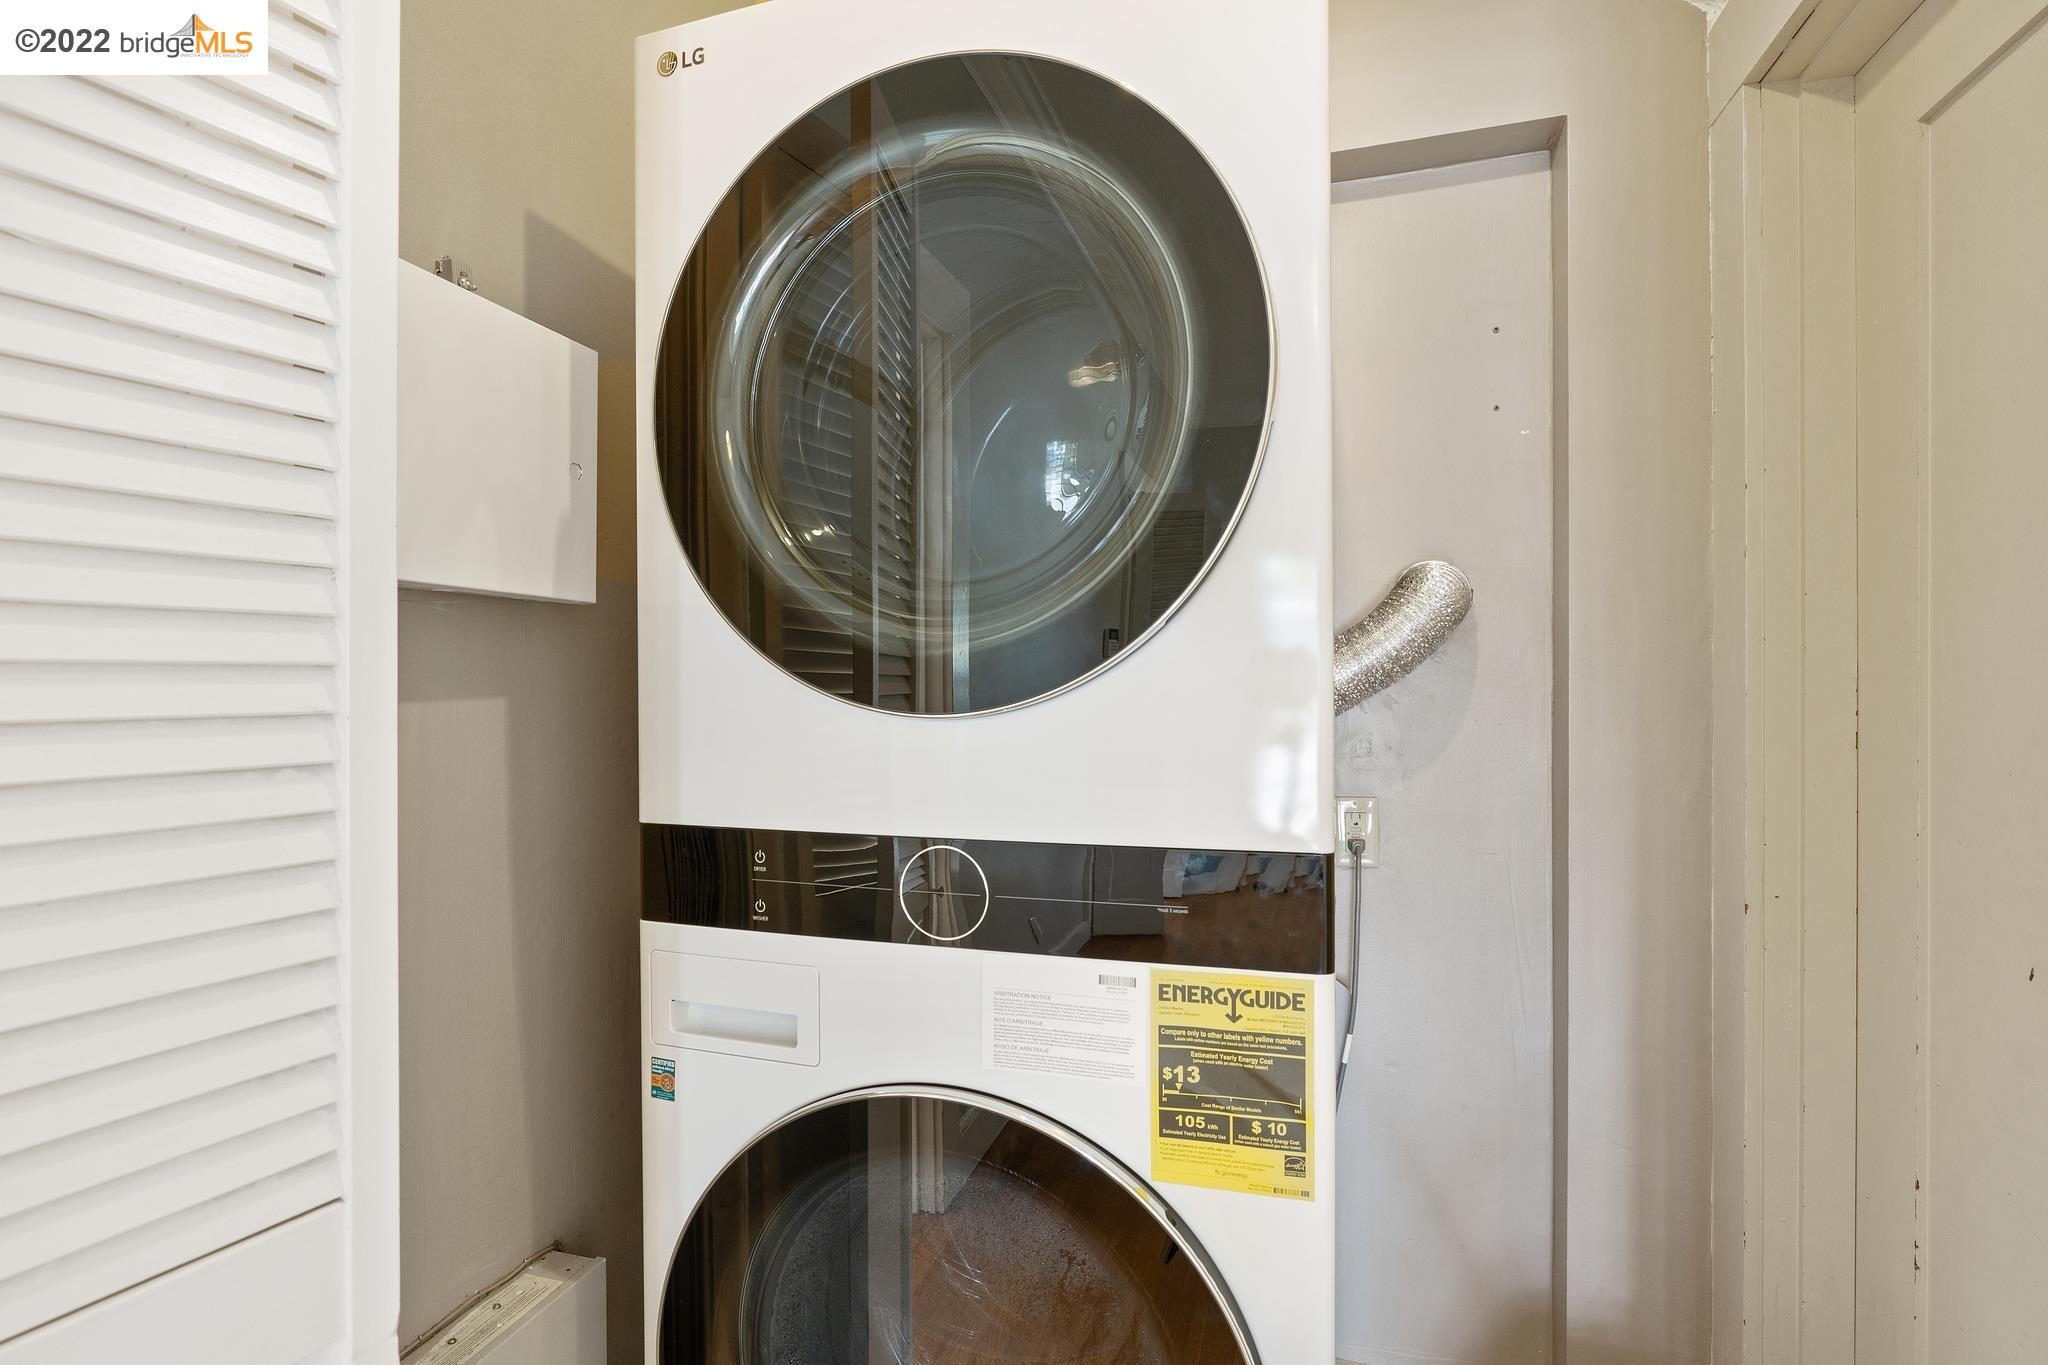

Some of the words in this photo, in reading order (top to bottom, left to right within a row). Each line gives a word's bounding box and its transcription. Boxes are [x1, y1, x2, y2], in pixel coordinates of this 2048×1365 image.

[682, 47, 705, 69] LG
[994, 991, 1030, 999] ARBITRATION
[1158, 983, 1306, 1012] ENERGYGUIDE
[1161, 1027, 1187, 1037] Compare
[1187, 1029, 1200, 1038] only
[1200, 1030, 1207, 1038] to
[1207, 1031, 1223, 1039] other
[1223, 1033, 1241, 1041] labels
[1241, 1034, 1255, 1042] with
[1255, 1035, 1275, 1044] yellow
[1275, 1038, 1303, 1046] numbers.
[1191, 1050, 1219, 1059] Estimated
[1219, 1053, 1237, 1062] Yearly
[1238, 1055, 1258, 1065] Energy
[1260, 1057, 1274, 1066] Cost
[1162, 1065, 1201, 1084] $13
[1175, 1114, 1206, 1129] 105
[1251, 1120, 1262, 1135] $
[1267, 1122, 1287, 1137] 10
[1162, 1128, 1183, 1136] Estimated
[1184, 1130, 1197, 1138] Yearly
[1196, 1131, 1218, 1140] Electricity
[1238, 1134, 1260, 1142] Estimated
[1274, 1138, 1289, 1146] Energy
